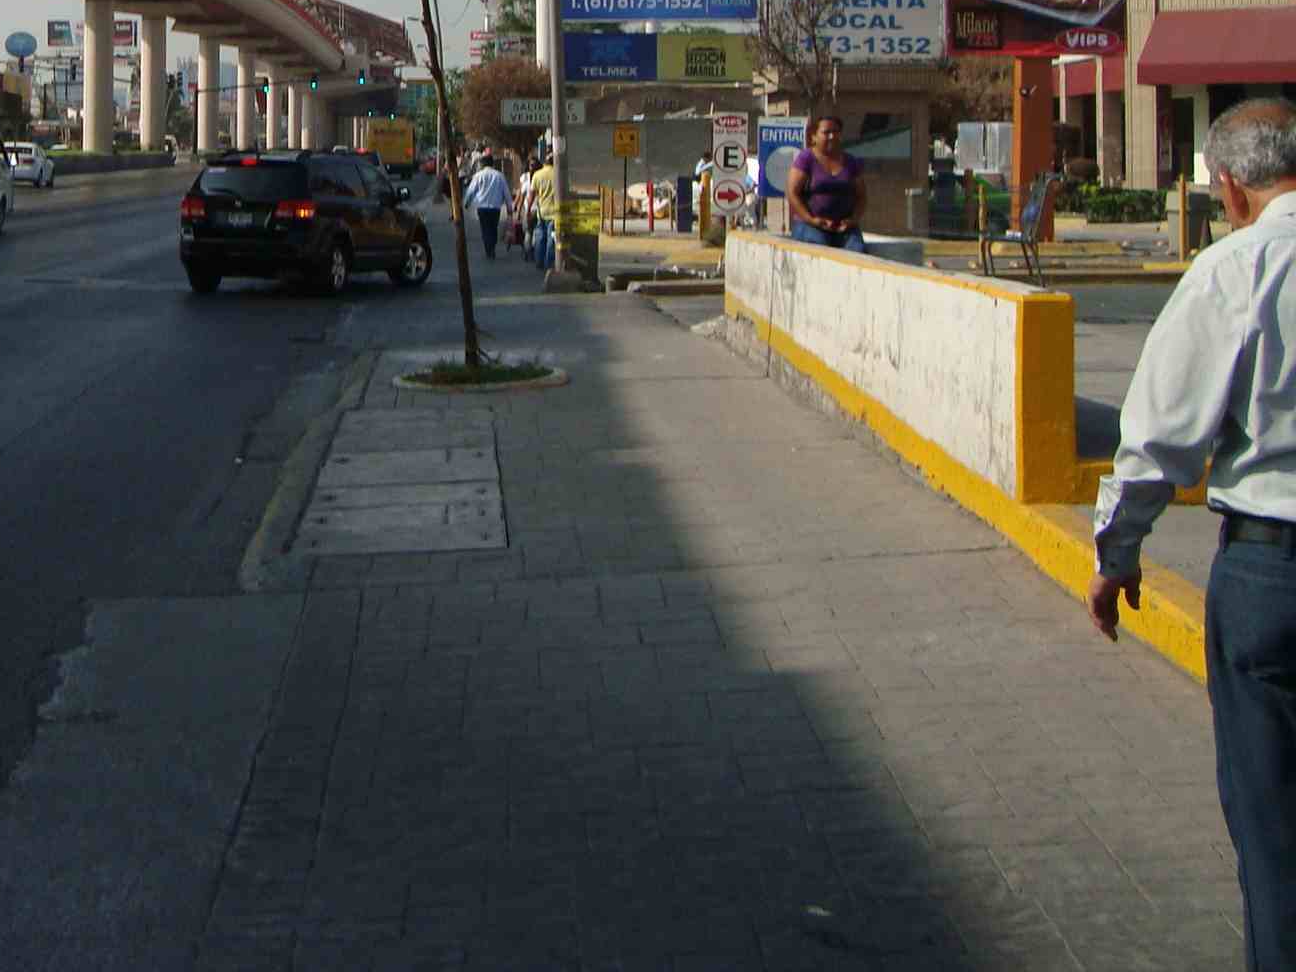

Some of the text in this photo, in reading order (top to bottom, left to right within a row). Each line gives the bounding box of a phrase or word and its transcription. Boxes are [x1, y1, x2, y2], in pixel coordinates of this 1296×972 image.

[1066, 32, 1108, 48] VIPS
[583, 66, 638, 77] TELMEX
[724, 146, 738, 167] E
